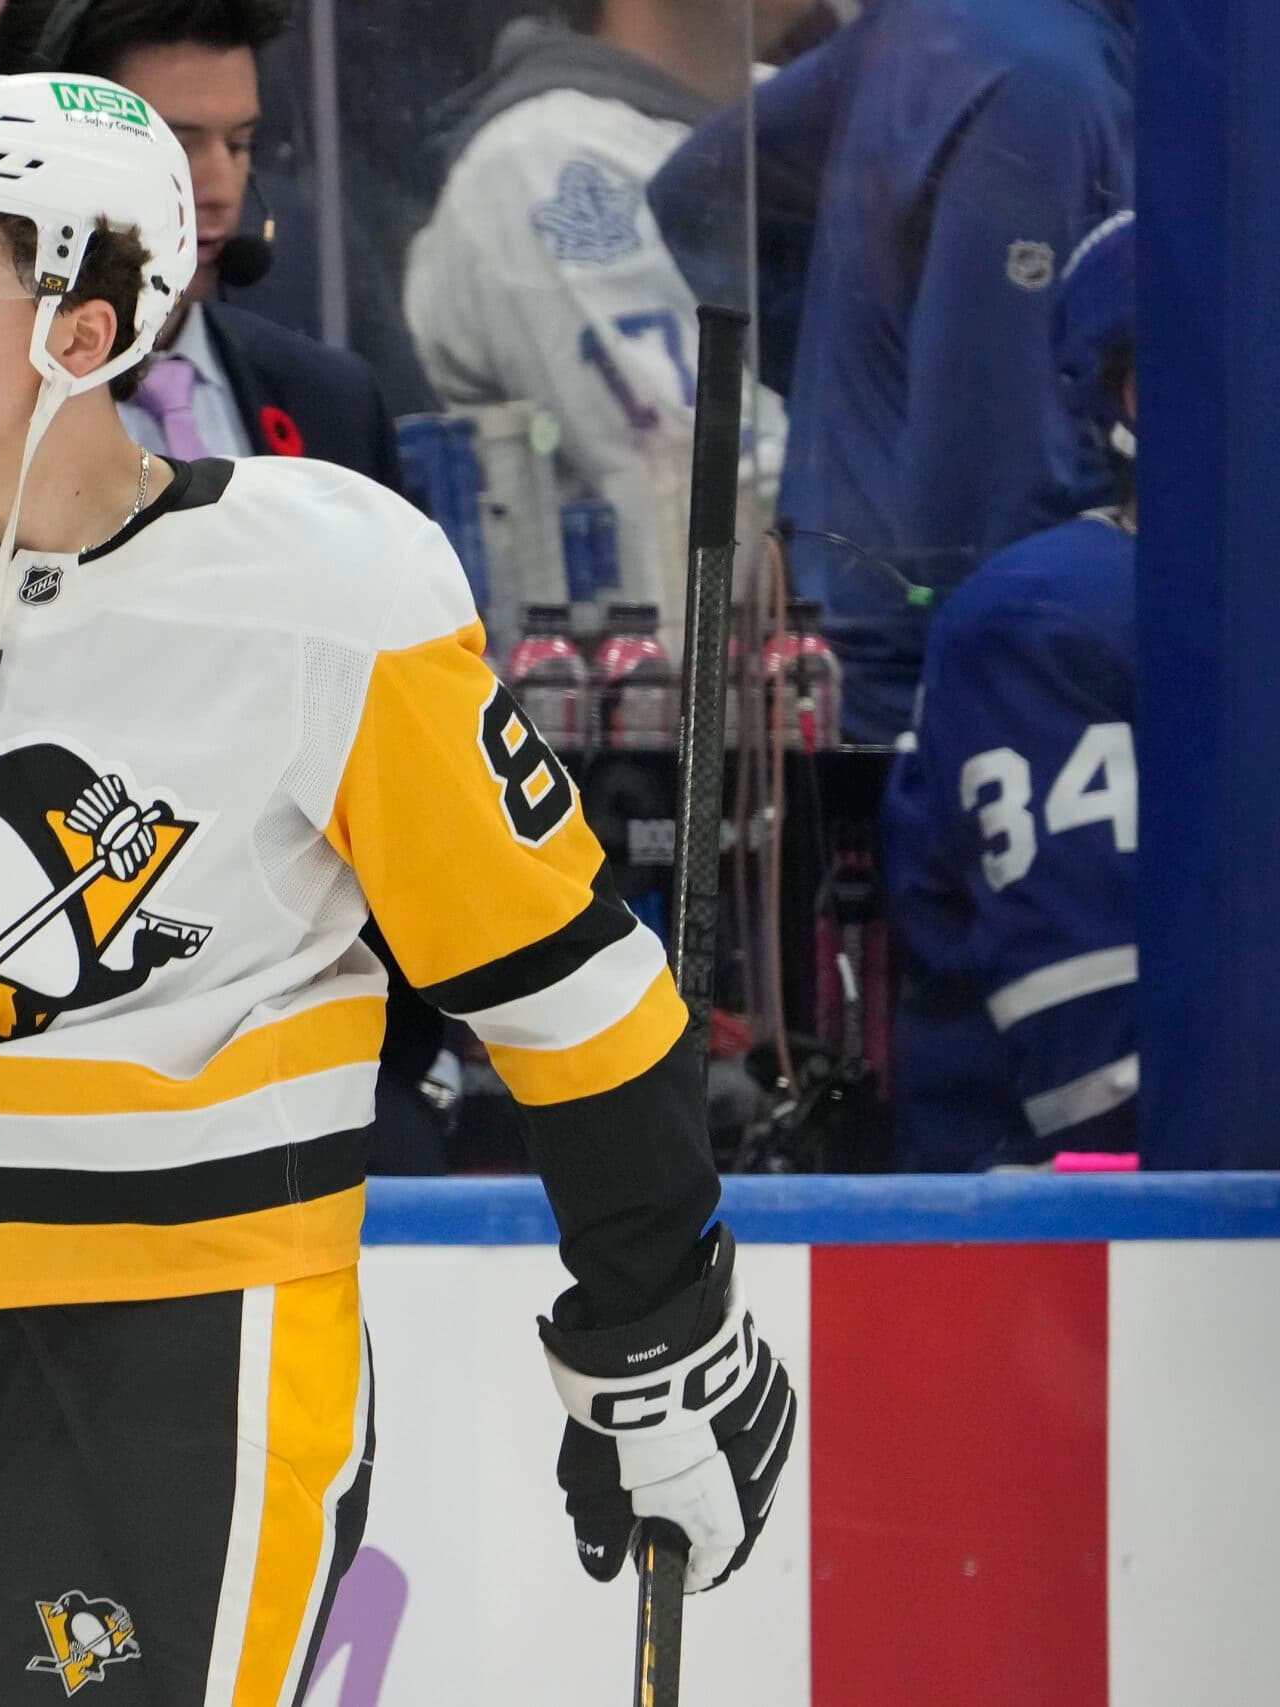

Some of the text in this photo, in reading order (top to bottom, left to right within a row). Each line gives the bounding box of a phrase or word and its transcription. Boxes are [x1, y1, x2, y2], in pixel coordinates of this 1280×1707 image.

[57, 84, 149, 125] MSA
[27, 575, 57, 598] NHL
[960, 721, 1140, 893] 34
[626, 1342, 669, 1364] KINDEL
